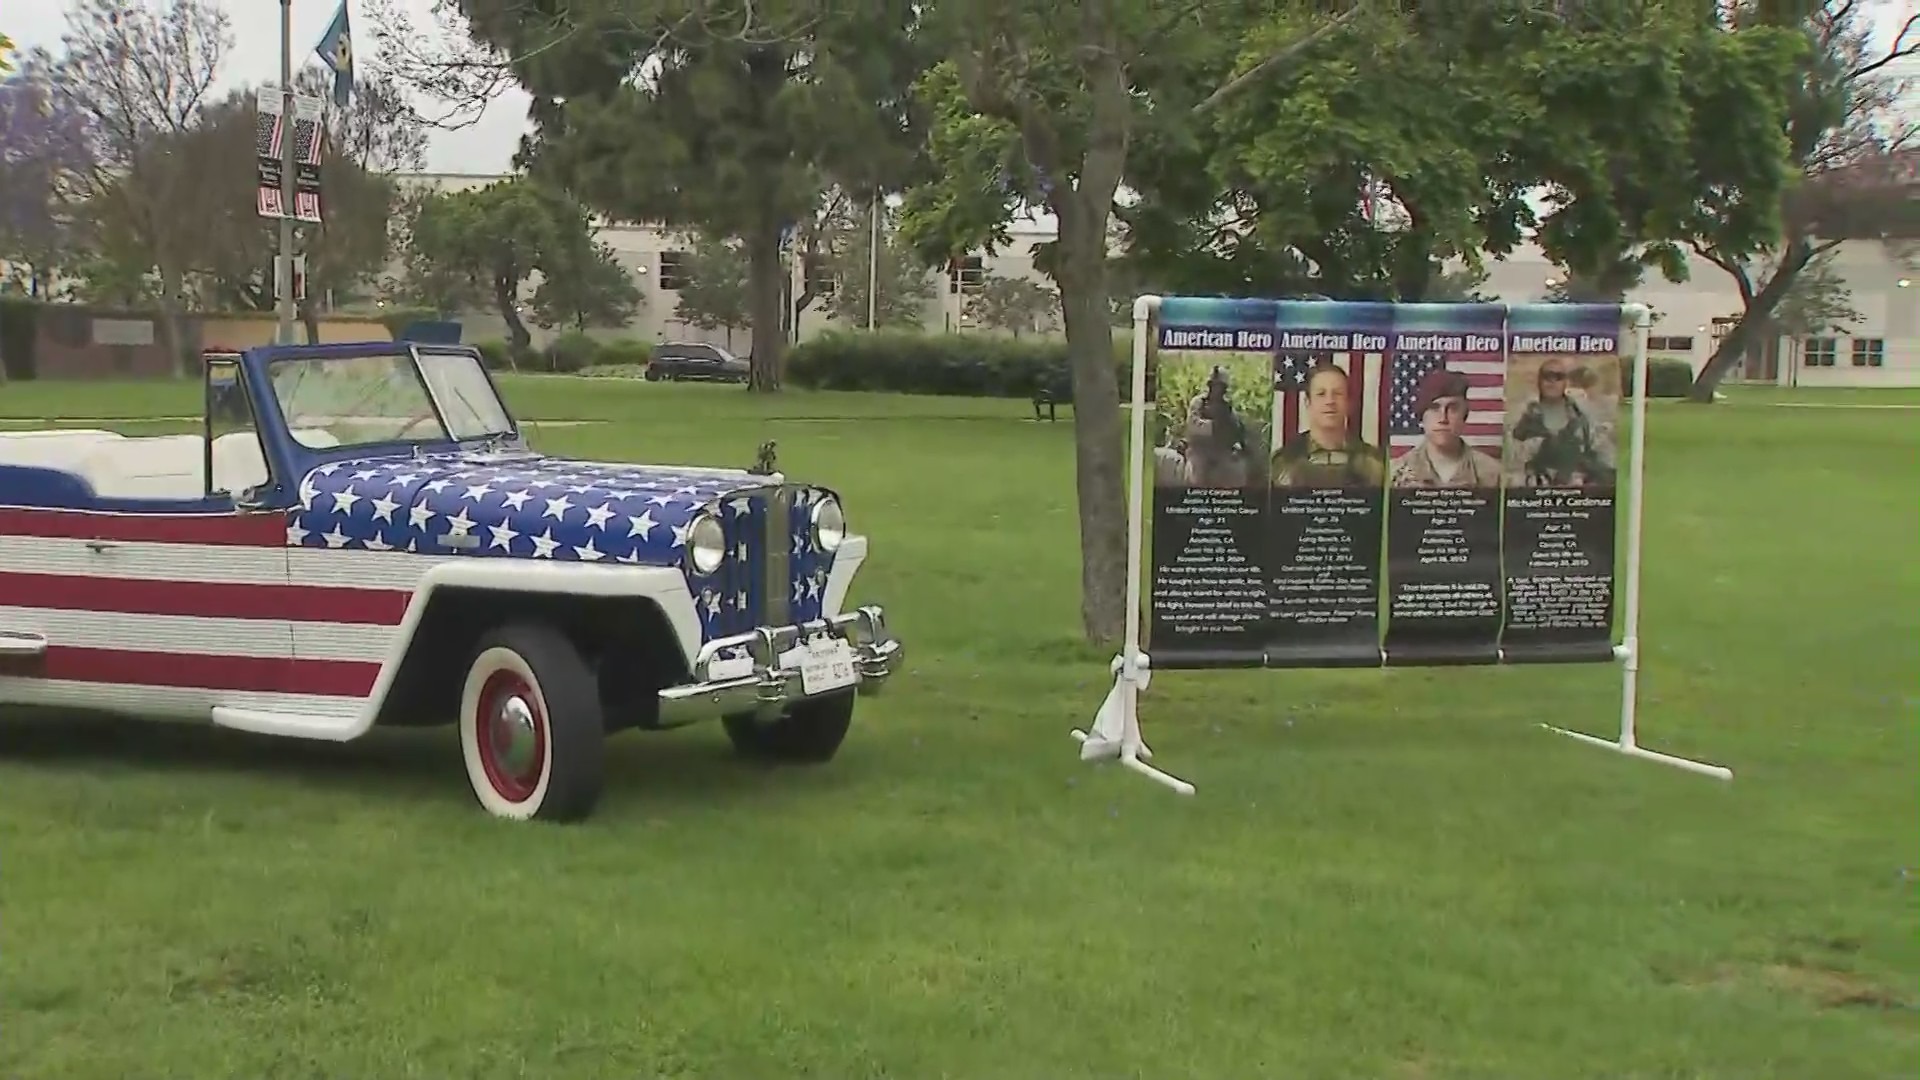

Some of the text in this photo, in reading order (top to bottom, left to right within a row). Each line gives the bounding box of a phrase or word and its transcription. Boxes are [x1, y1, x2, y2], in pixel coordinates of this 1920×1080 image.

[1164, 330, 1272, 348] American Hero
[1280, 332, 1386, 350] American Hero
[1396, 334, 1500, 351] American Hero
[1512, 335, 1614, 352] American Hero
[1166, 506, 1190, 514] United
[1506, 498, 1542, 508] Michael
